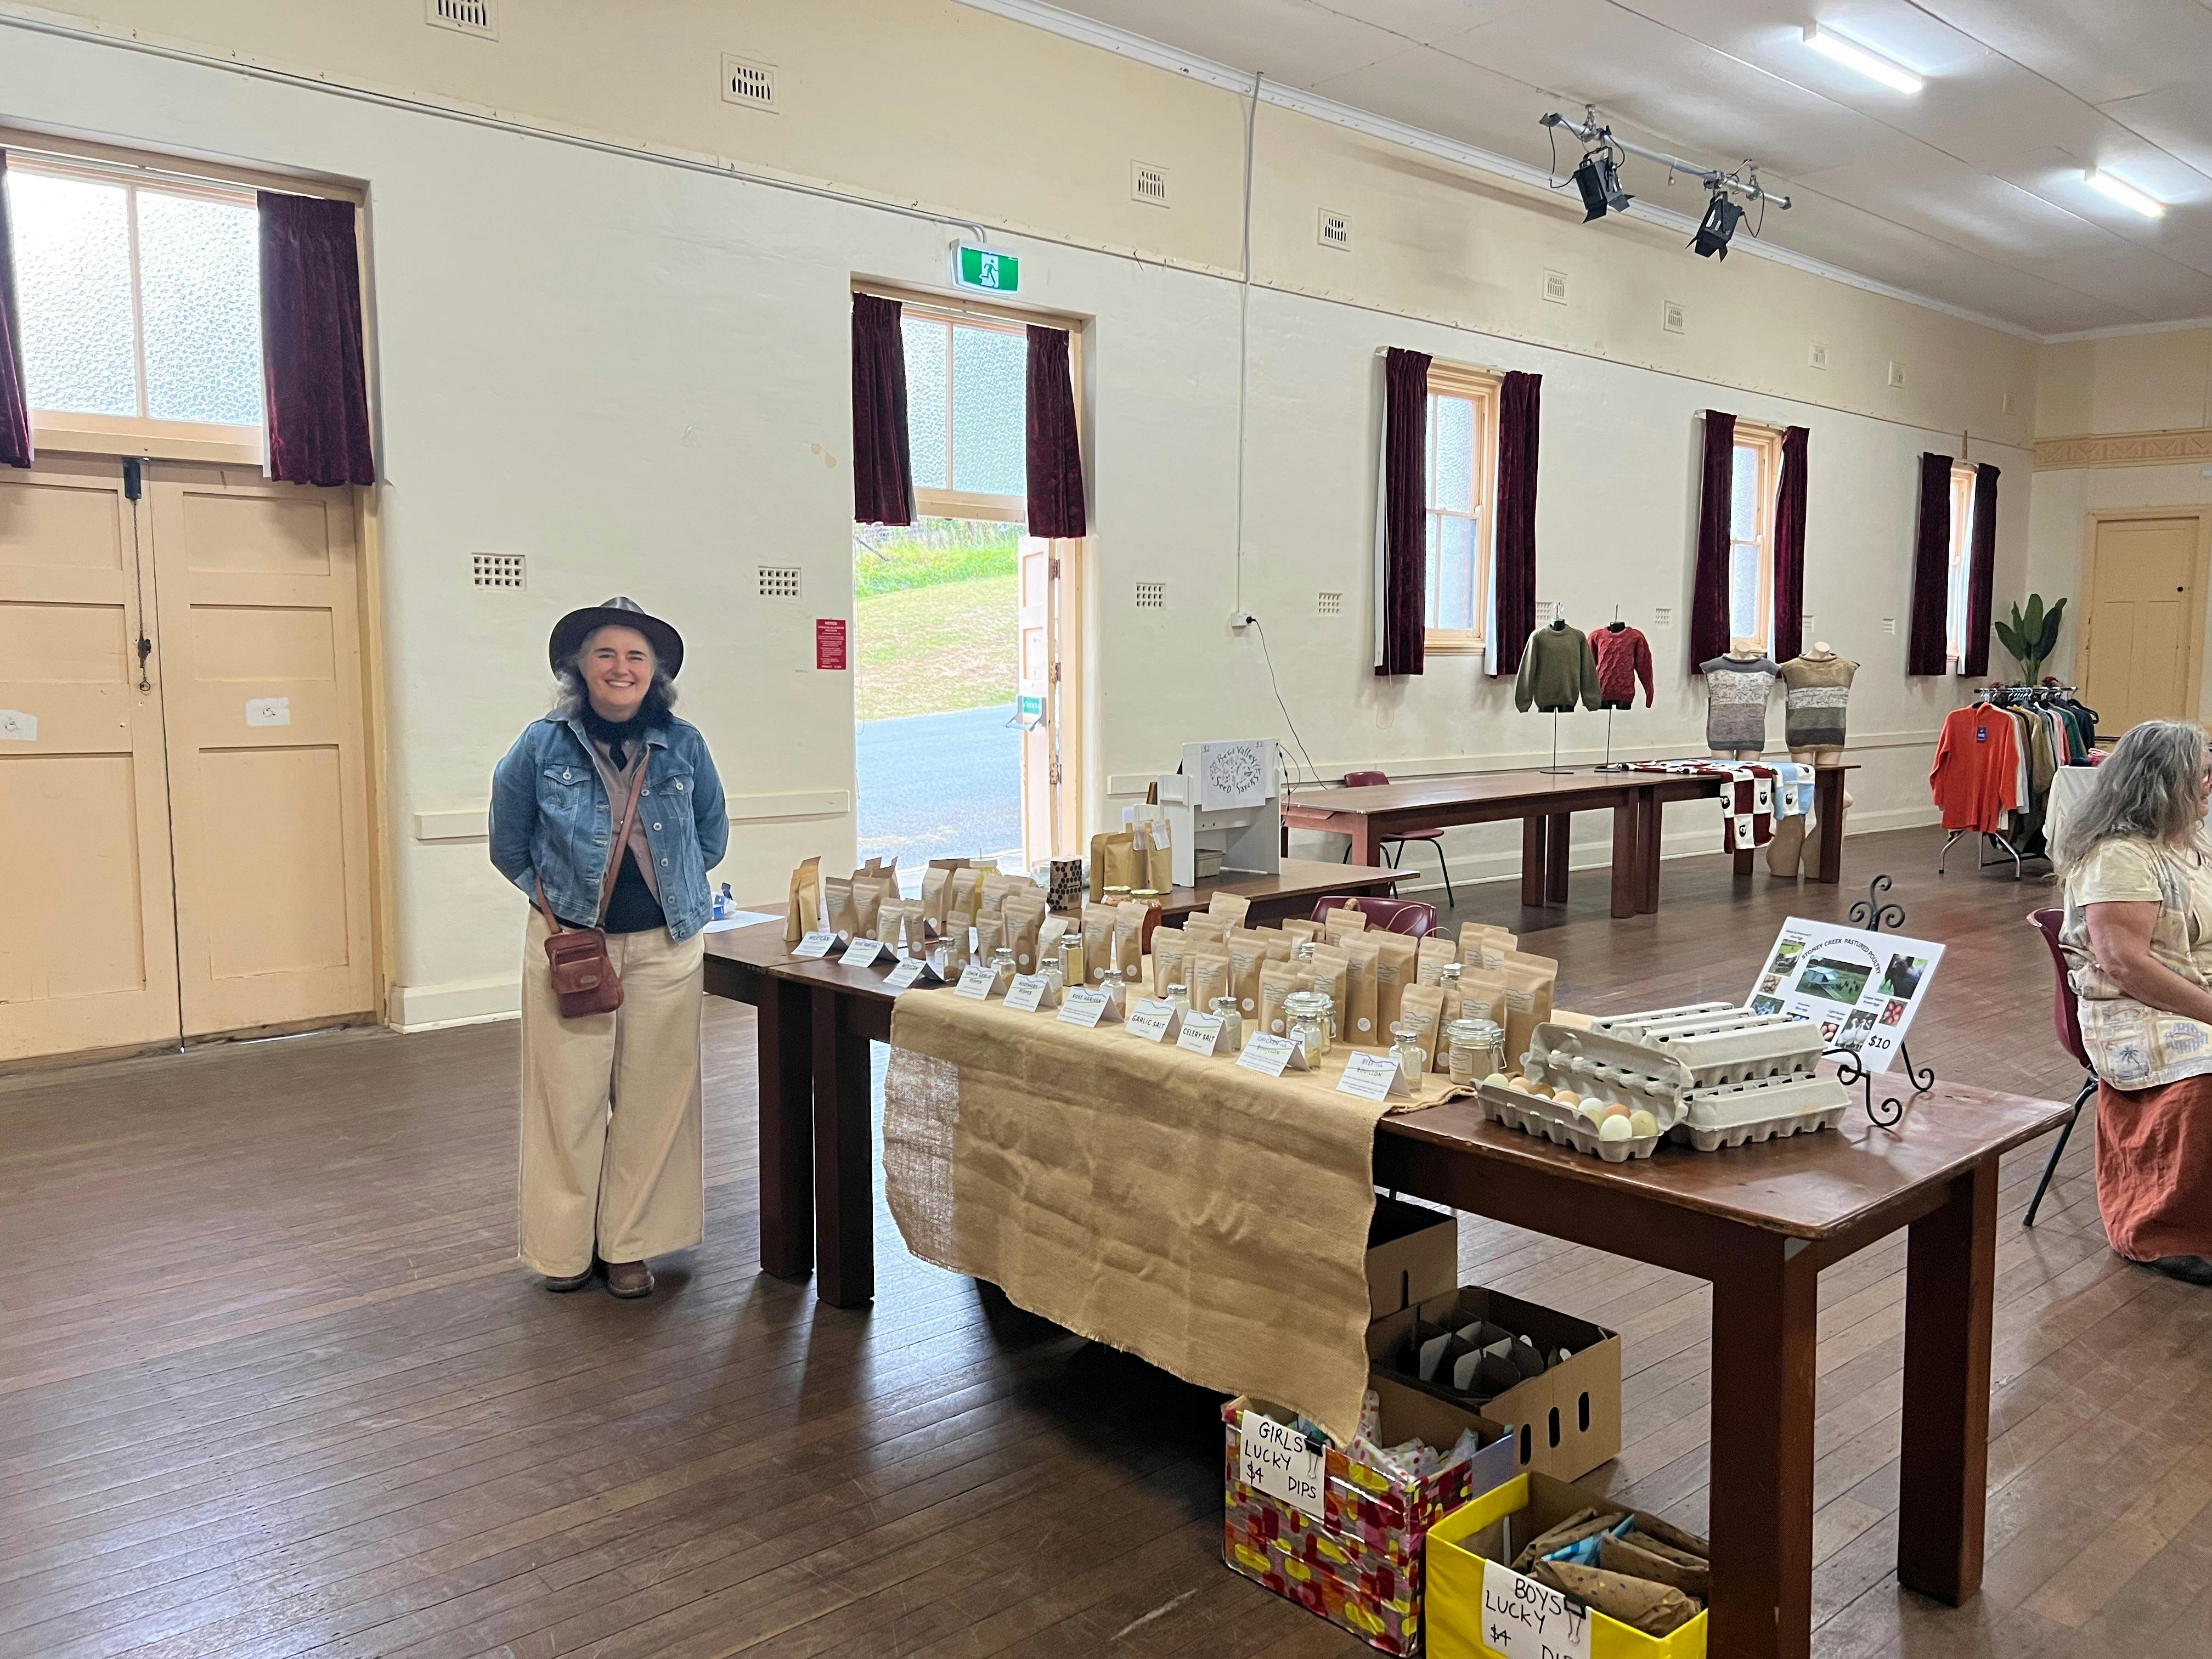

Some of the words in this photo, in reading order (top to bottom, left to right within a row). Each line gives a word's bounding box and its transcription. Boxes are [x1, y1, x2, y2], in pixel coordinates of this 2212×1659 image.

[1237, 746, 1257, 764] Valley
[1802, 944, 1822, 960] STONEY
[1824, 938, 1842, 946] CREEK
[1844, 939, 1869, 952] PASTURED
[1867, 951, 1881, 974] POULTRY
[1132, 1014, 1152, 1026] GARLIC
[1153, 1021, 1165, 1029] SALT
[1183, 1028, 1202, 1039] CELERY
[1203, 1034, 1215, 1042] SALT
[1868, 1035, 1891, 1049] $10
[1259, 1421, 1302, 1453] GIRLS
[1244, 1439, 1291, 1470] LUCKY
[1246, 1460, 1264, 1485] $4
[1288, 1476, 1316, 1499] DIPS
[1486, 1589, 1545, 1634] LUCKY
[1515, 1578, 1561, 1615] BOYS
[1490, 1623, 1511, 1646] $4
